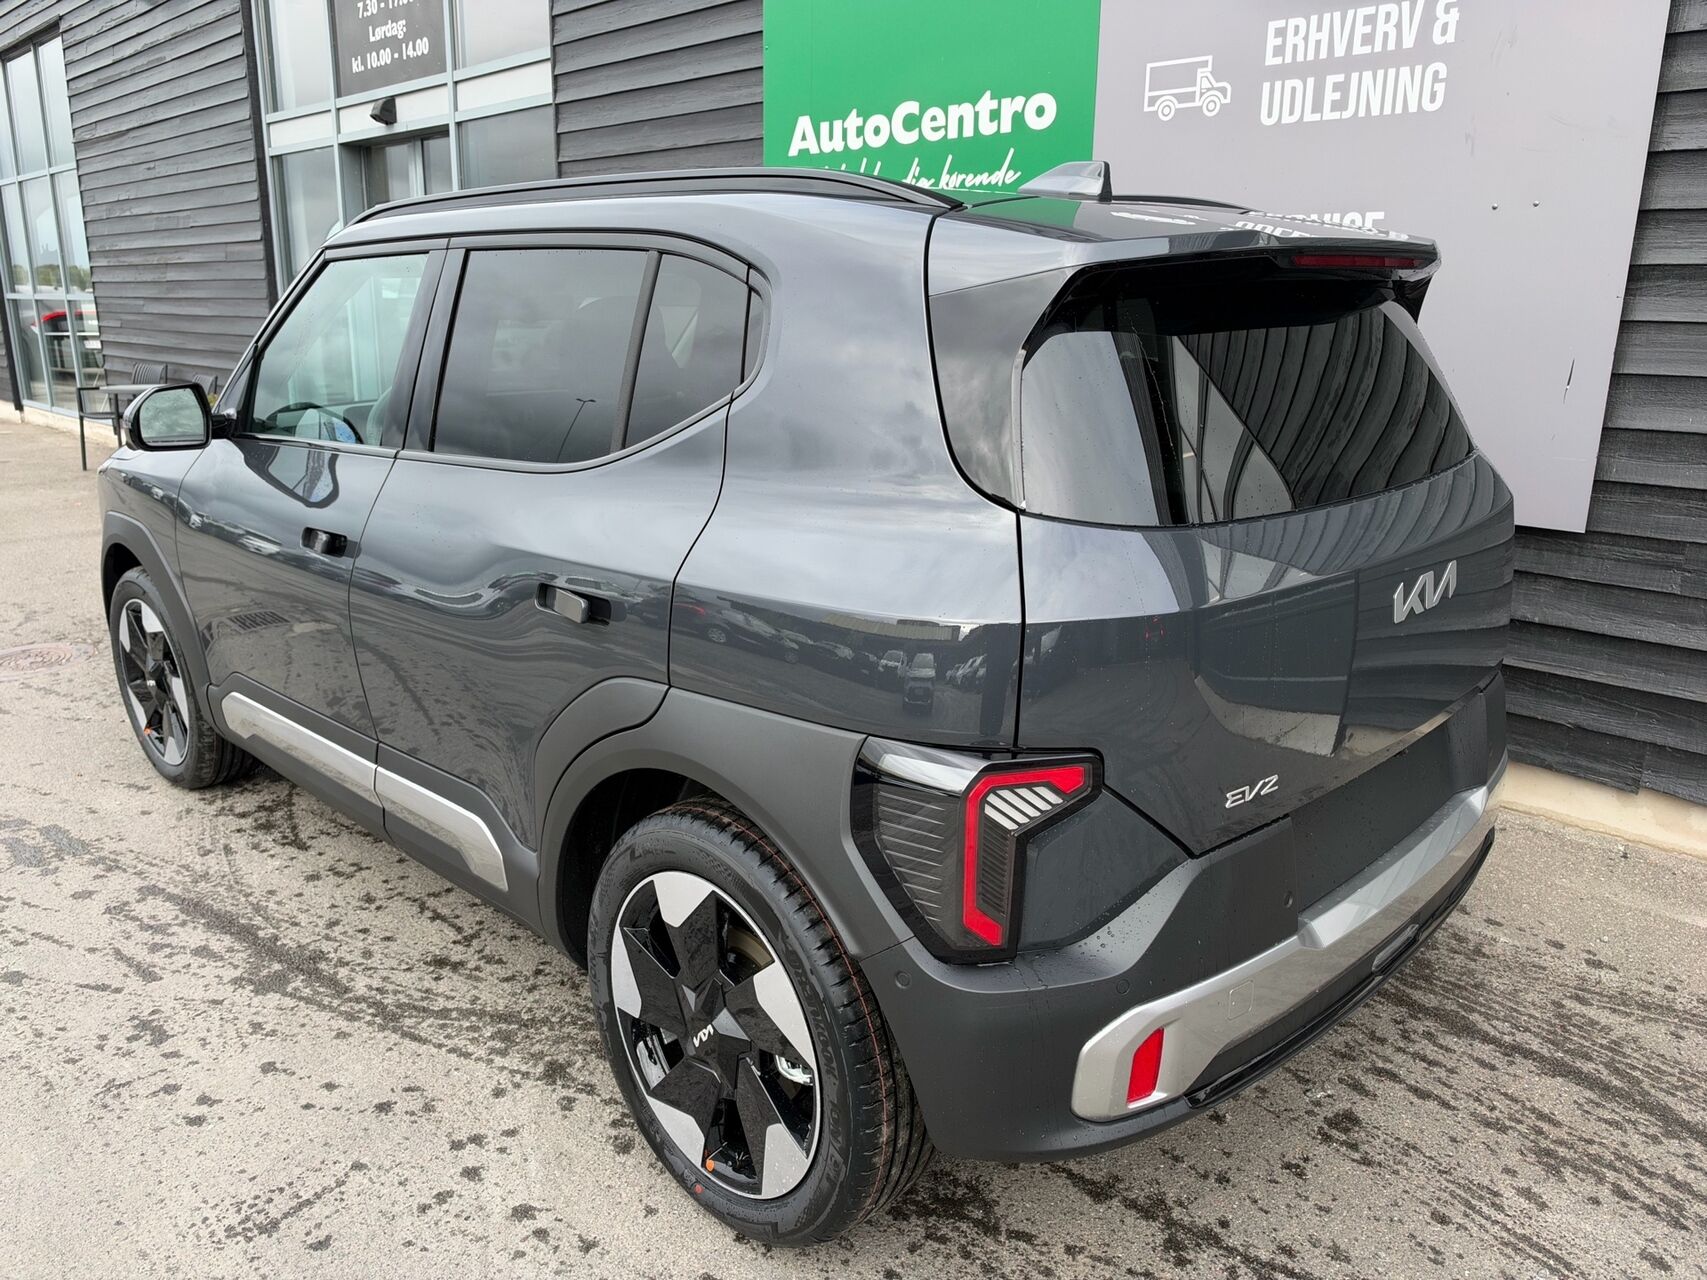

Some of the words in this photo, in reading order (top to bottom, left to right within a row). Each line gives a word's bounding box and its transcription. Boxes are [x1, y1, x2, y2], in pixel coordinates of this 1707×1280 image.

[351, 56, 365, 73] kl.
[366, 48, 392, 69] 10.00
[402, 37, 429, 60] 14.00
[368, 19, 407, 42] Lørdag:
[1264, 0, 1426, 66] ERHVERV
[787, 89, 1058, 157] AutoCentro
[1260, 62, 1449, 126] UDLEJNING
[1393, 559, 1457, 624] KIA
[1225, 774, 1279, 809] EV2
